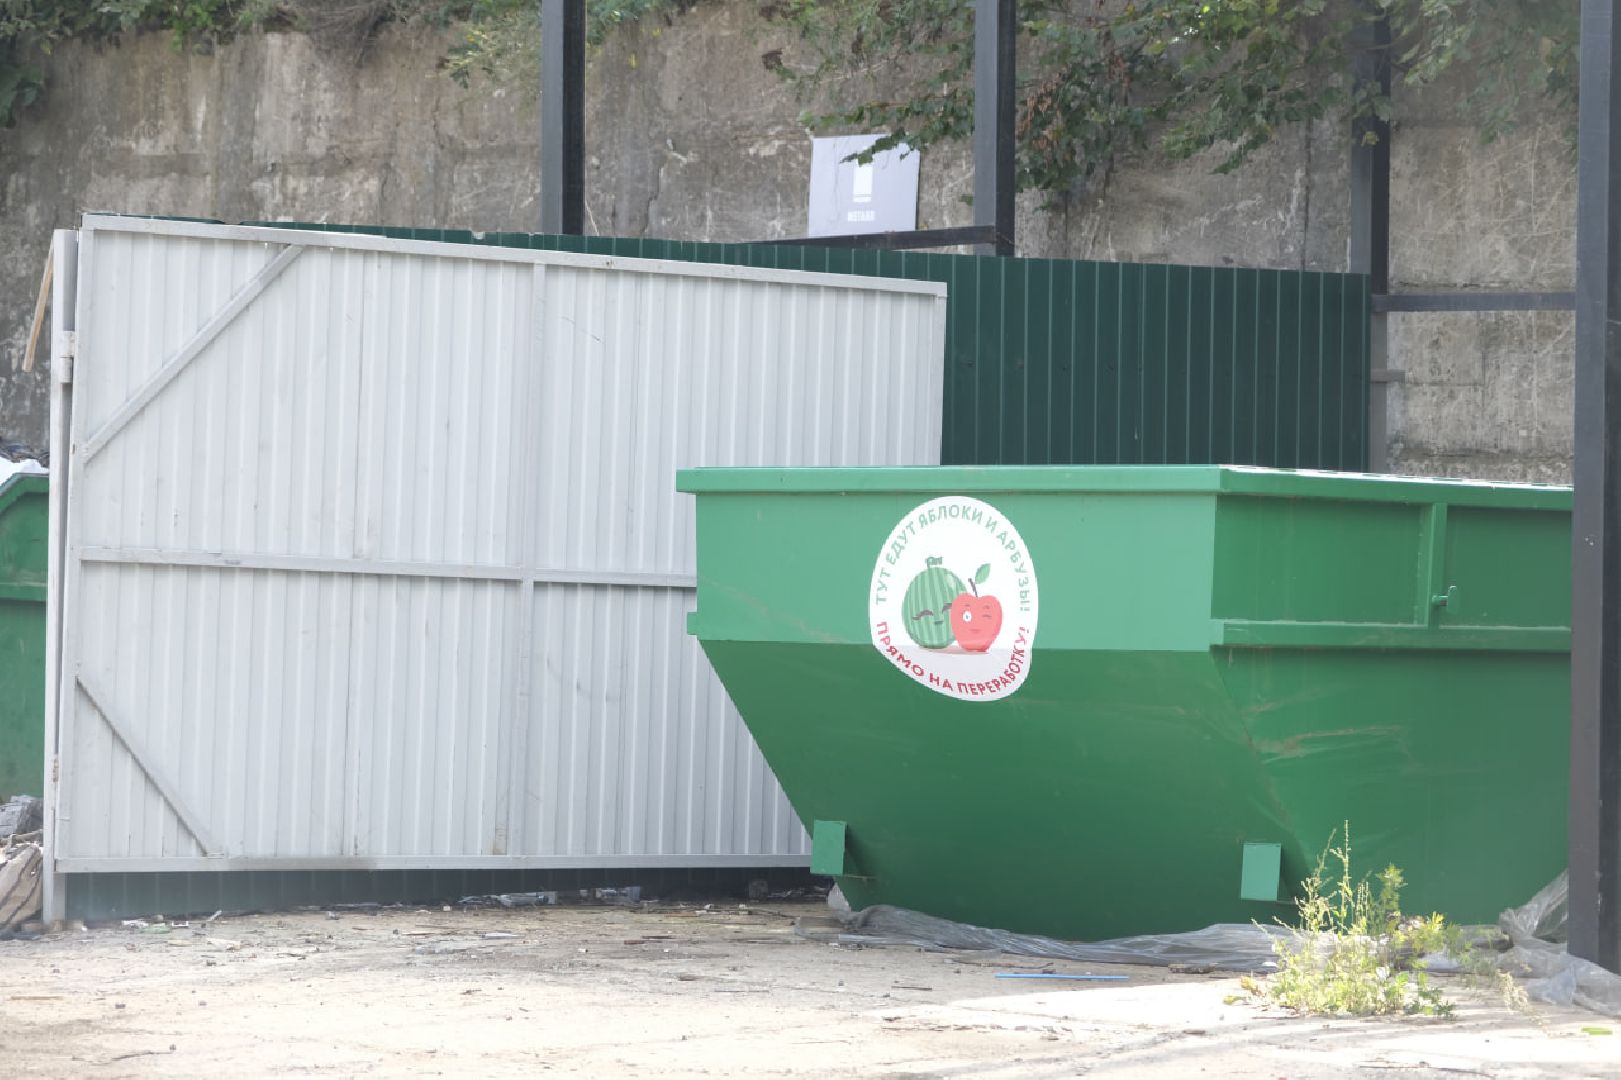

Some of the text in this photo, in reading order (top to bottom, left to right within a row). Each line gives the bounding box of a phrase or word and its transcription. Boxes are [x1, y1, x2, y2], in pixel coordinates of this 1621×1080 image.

[876, 504, 1031, 611] ТУТ ЕДУТ ЯБЛОКИ И АРБУЗЫ!
[876, 621, 1030, 696] ПРЯМО НА ПЕРЕРАБОТКУ!
